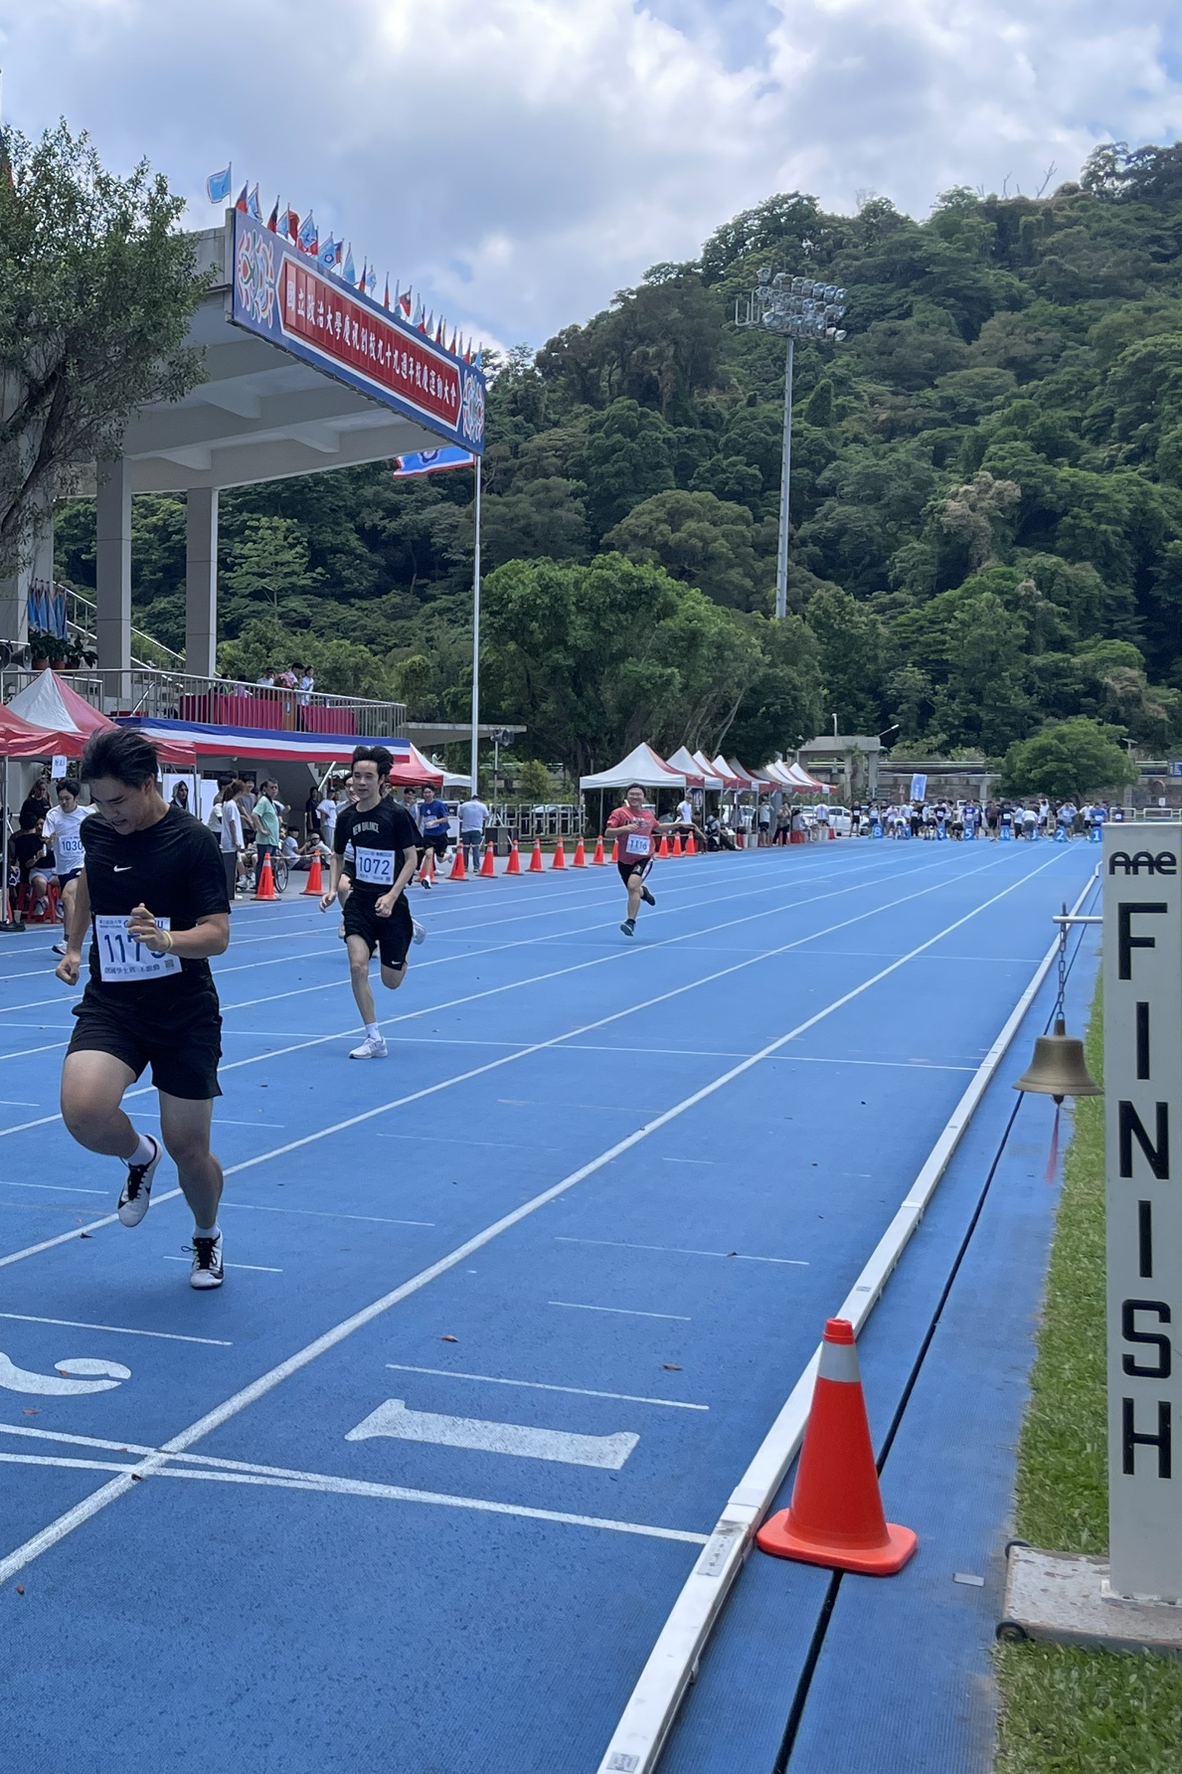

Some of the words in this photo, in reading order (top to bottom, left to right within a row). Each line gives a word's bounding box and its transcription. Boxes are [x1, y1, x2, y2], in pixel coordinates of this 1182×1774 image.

[1056, 829, 1064, 840] 2
[1093, 830, 1100, 841] 1
[359, 857, 391, 875] 1072
[104, 934, 167, 963] 117
[1117, 902, 1171, 1479] FINISH
[345, 1398, 641, 1470] 1
